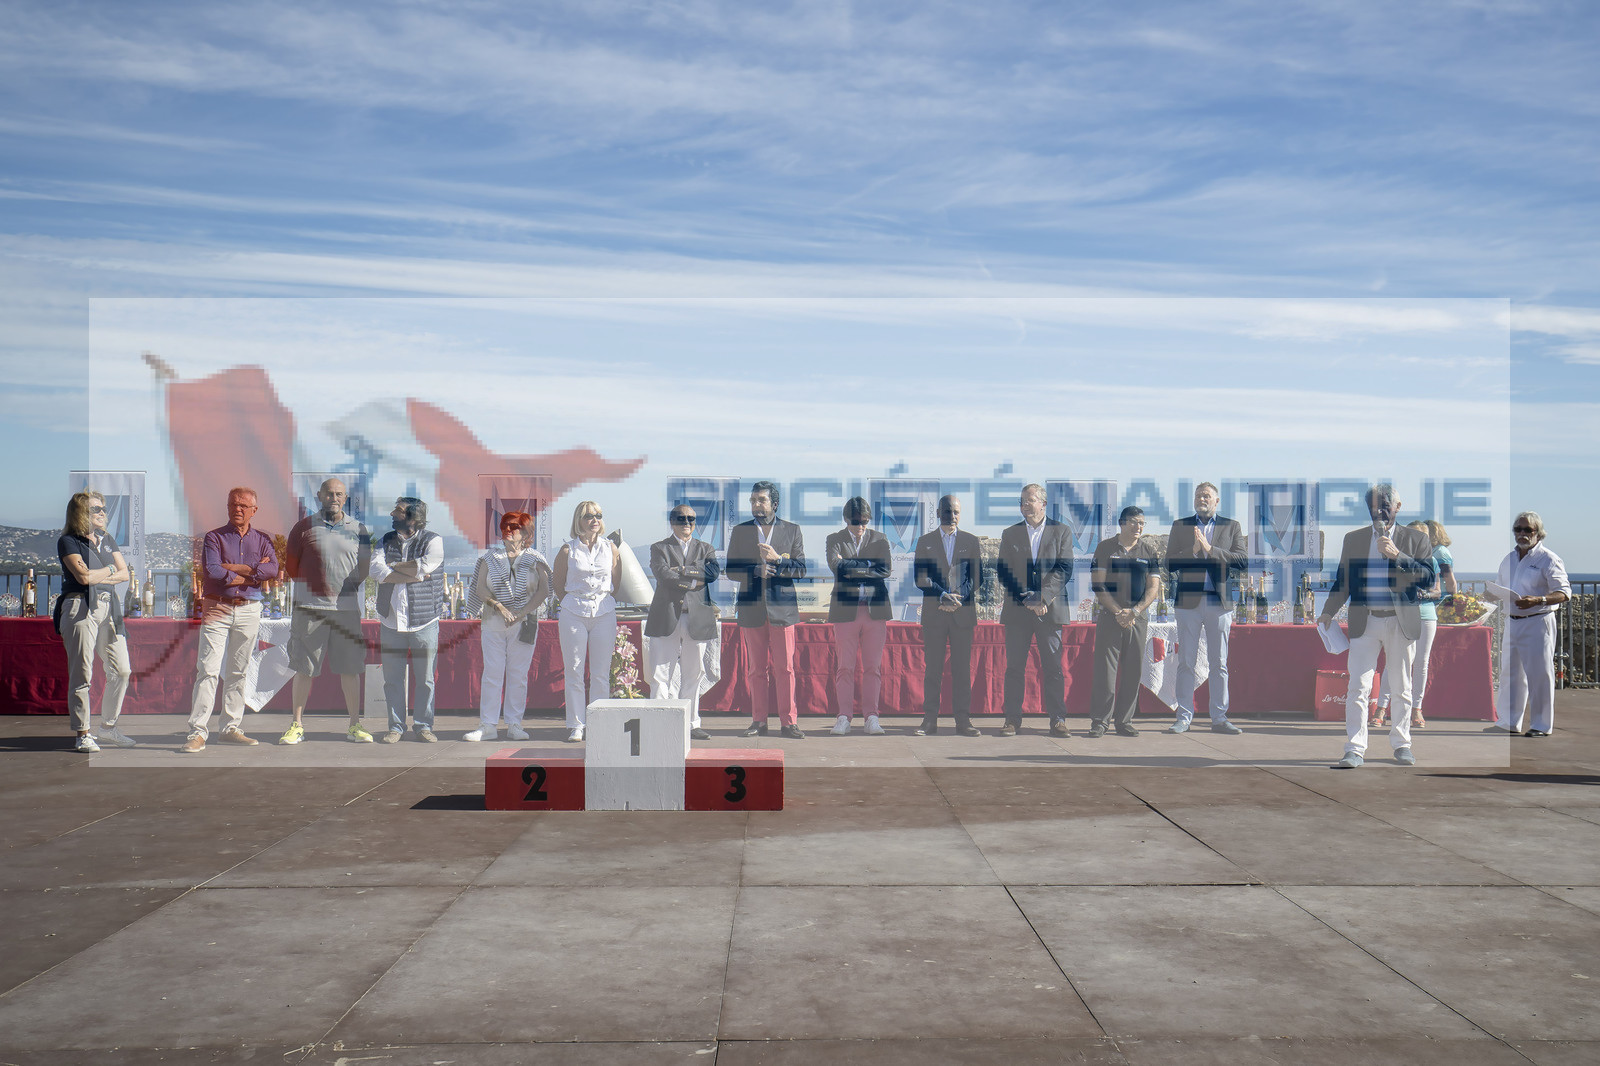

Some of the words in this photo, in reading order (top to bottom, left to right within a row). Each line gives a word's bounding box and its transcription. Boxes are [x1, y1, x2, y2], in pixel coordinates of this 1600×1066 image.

[132, 494, 140, 556] Saint-Tropez
[624, 718, 641, 756] 1
[521, 764, 548, 801] 2
[724, 764, 747, 802] 3
